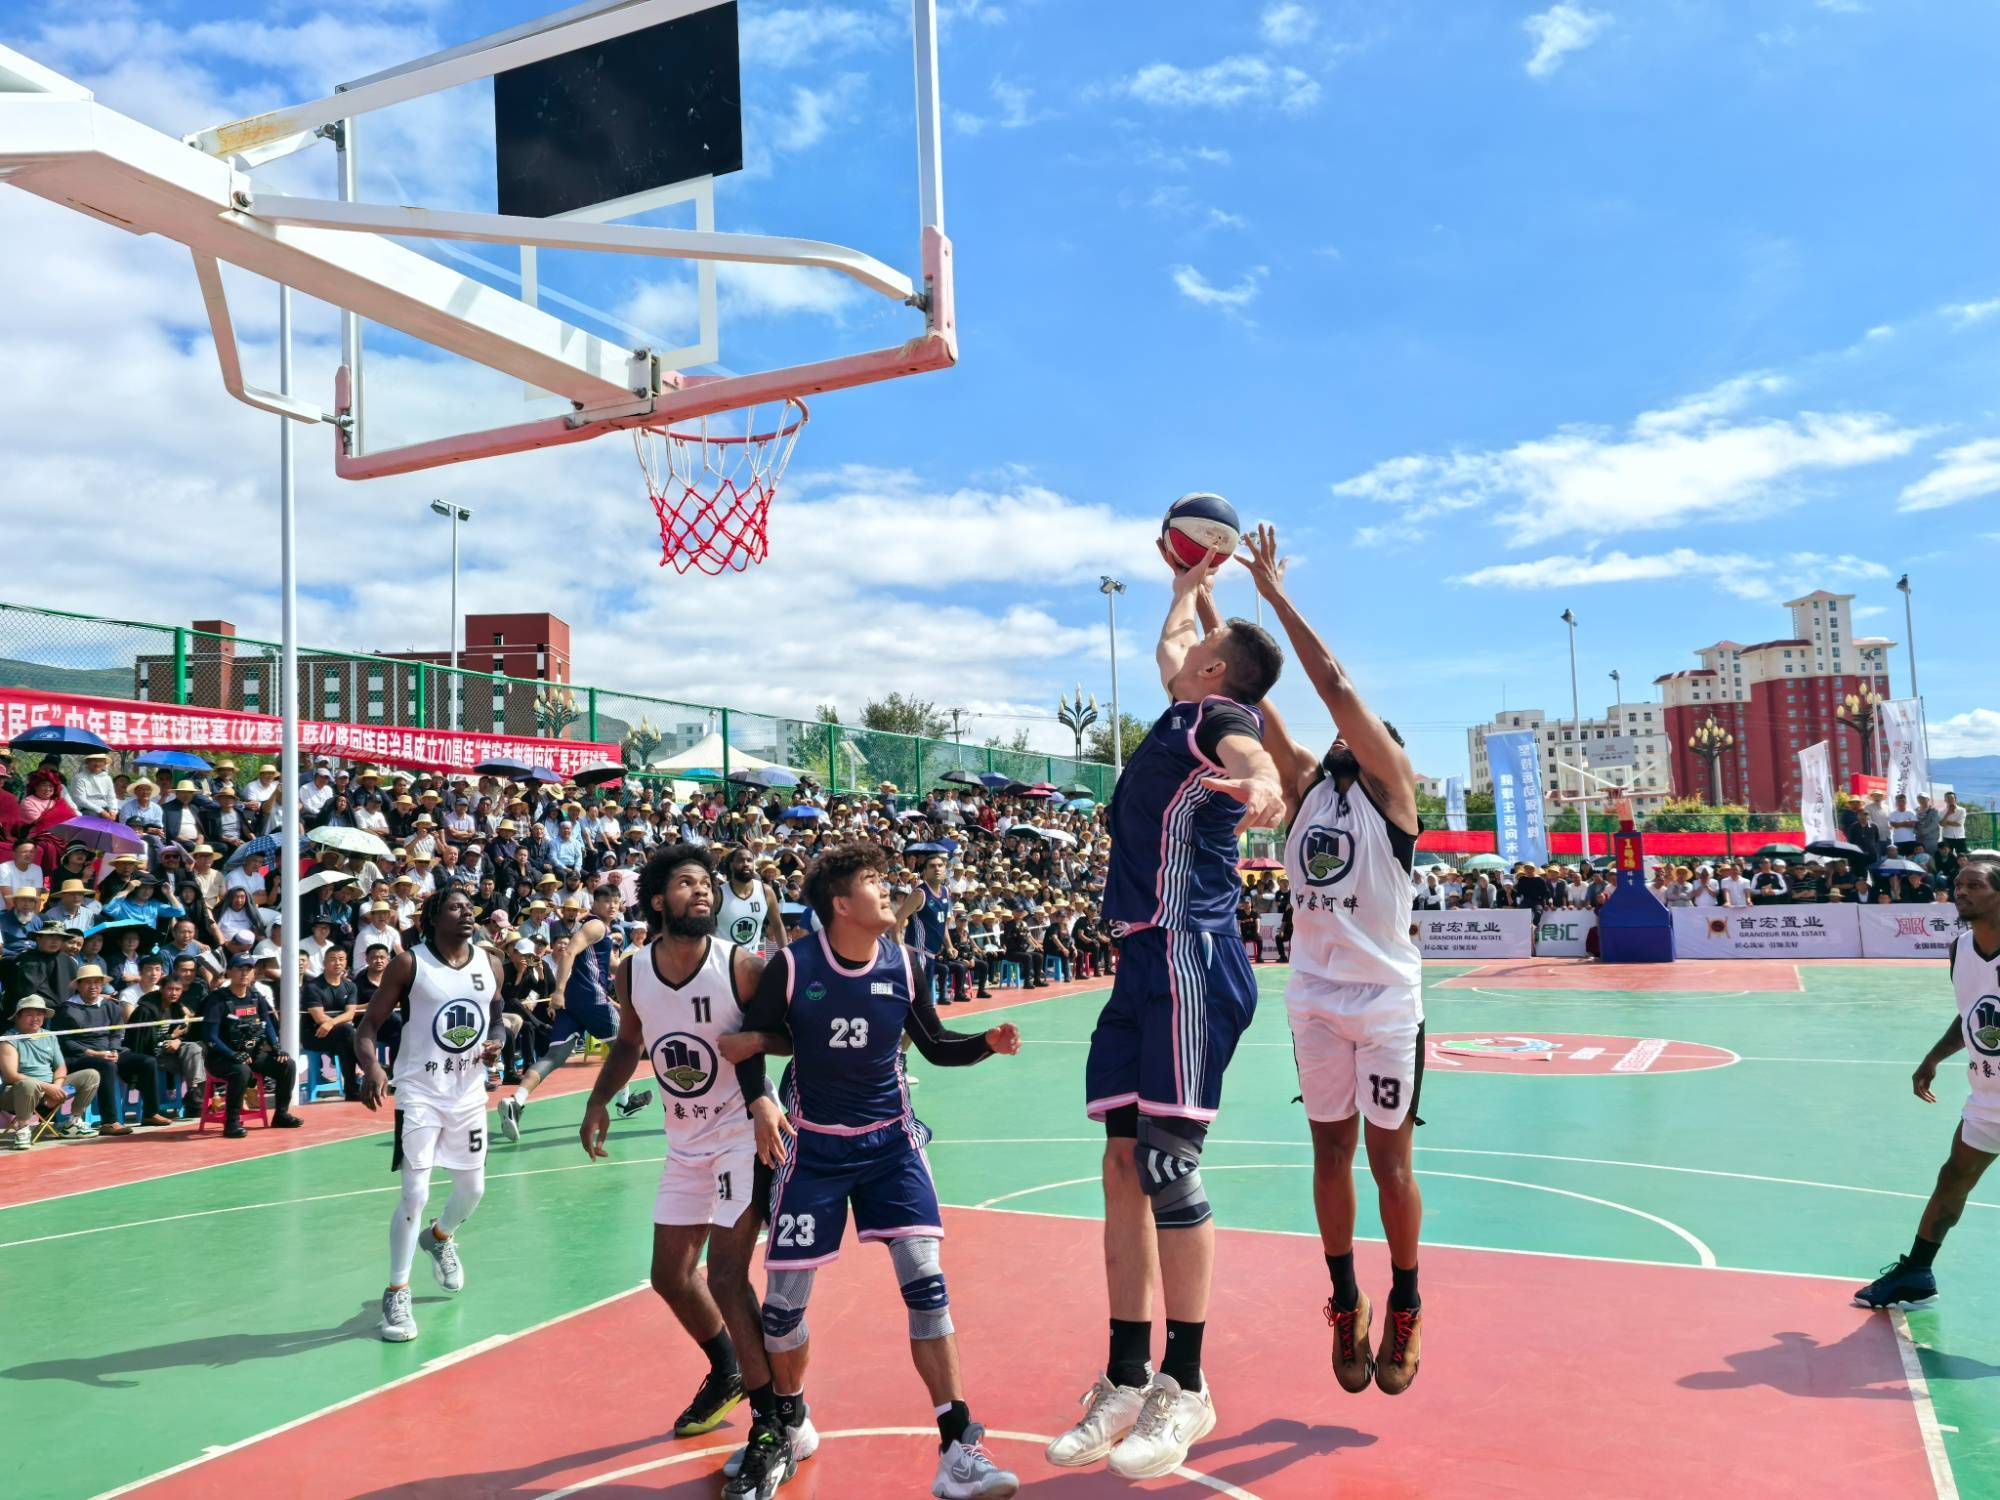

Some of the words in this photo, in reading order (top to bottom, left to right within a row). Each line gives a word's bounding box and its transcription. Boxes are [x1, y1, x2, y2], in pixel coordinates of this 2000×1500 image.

[749, 901, 761, 914] 10
[1428, 921, 1501, 933] 首宏置业
[1536, 923, 1579, 942] 食汇
[1736, 916, 1824, 929] 首宏置业
[470, 973, 485, 991] 5
[690, 995, 712, 1023] 11
[828, 1016, 869, 1049] 23
[1368, 1073, 1401, 1110] 13
[468, 1128, 483, 1152] 5
[777, 1213, 816, 1247] 23
